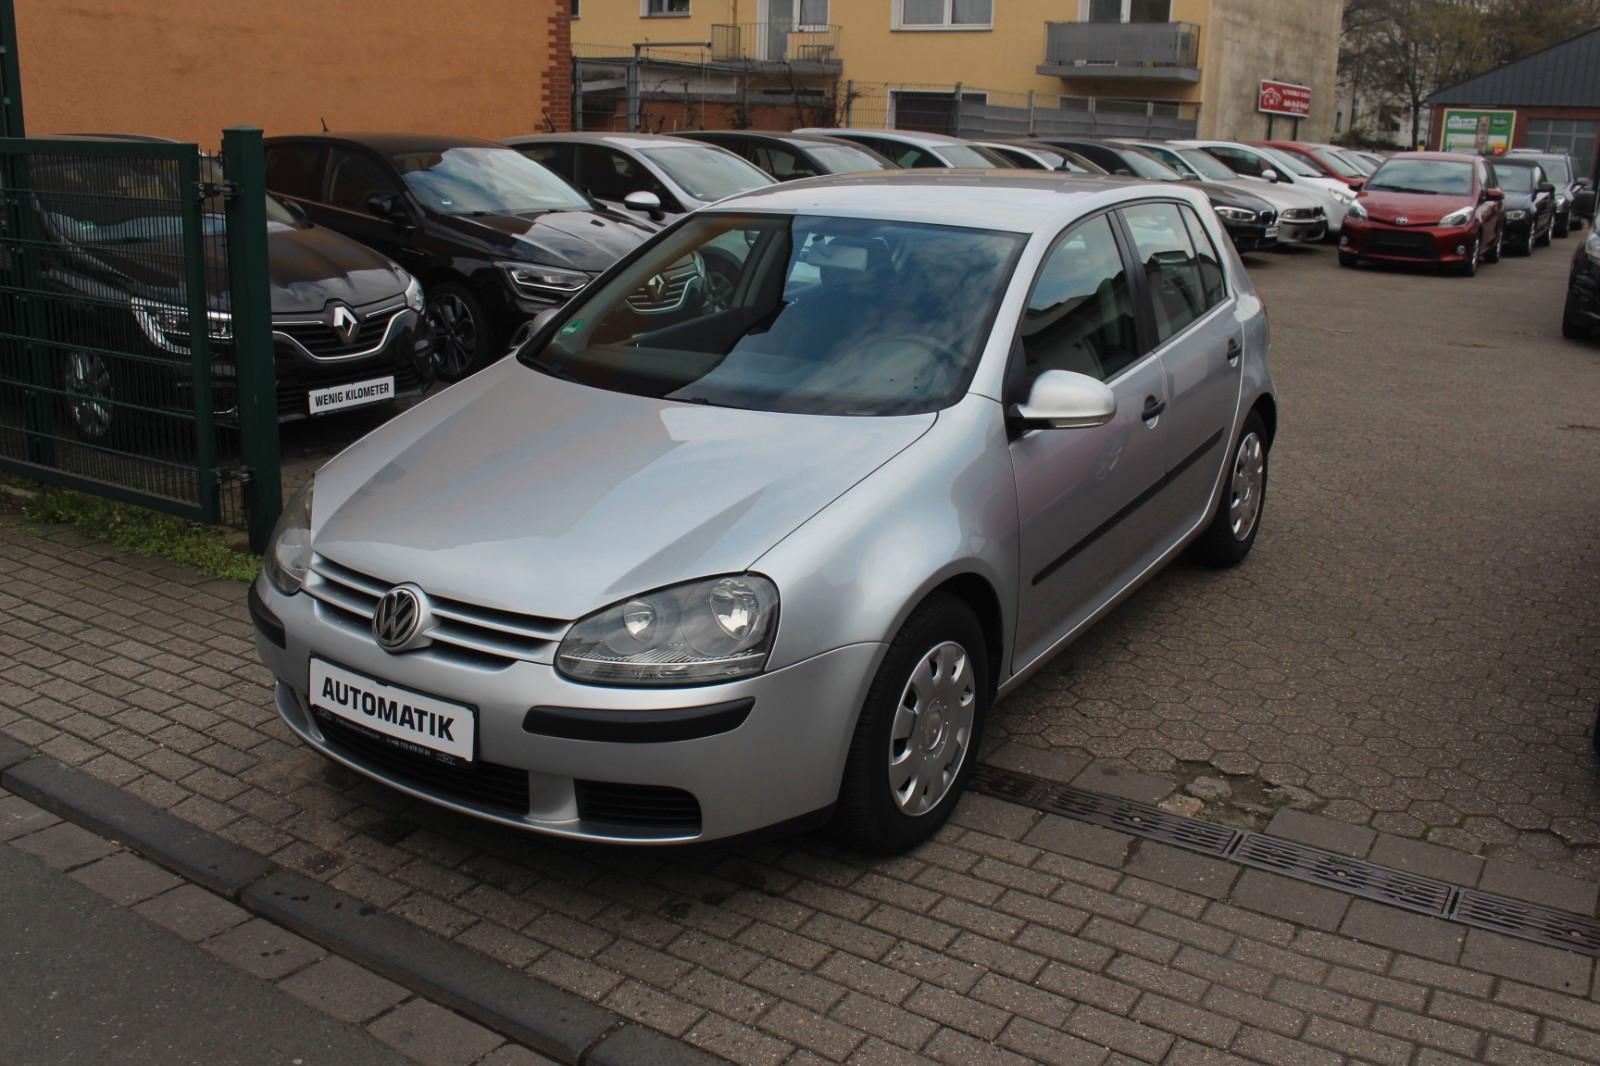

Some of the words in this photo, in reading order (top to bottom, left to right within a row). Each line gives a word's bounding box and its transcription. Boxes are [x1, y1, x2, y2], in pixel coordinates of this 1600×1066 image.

[316, 392, 343, 406] WENIG
[346, 383, 389, 400] KILOMETER
[321, 676, 455, 743] AUTOMATIK
